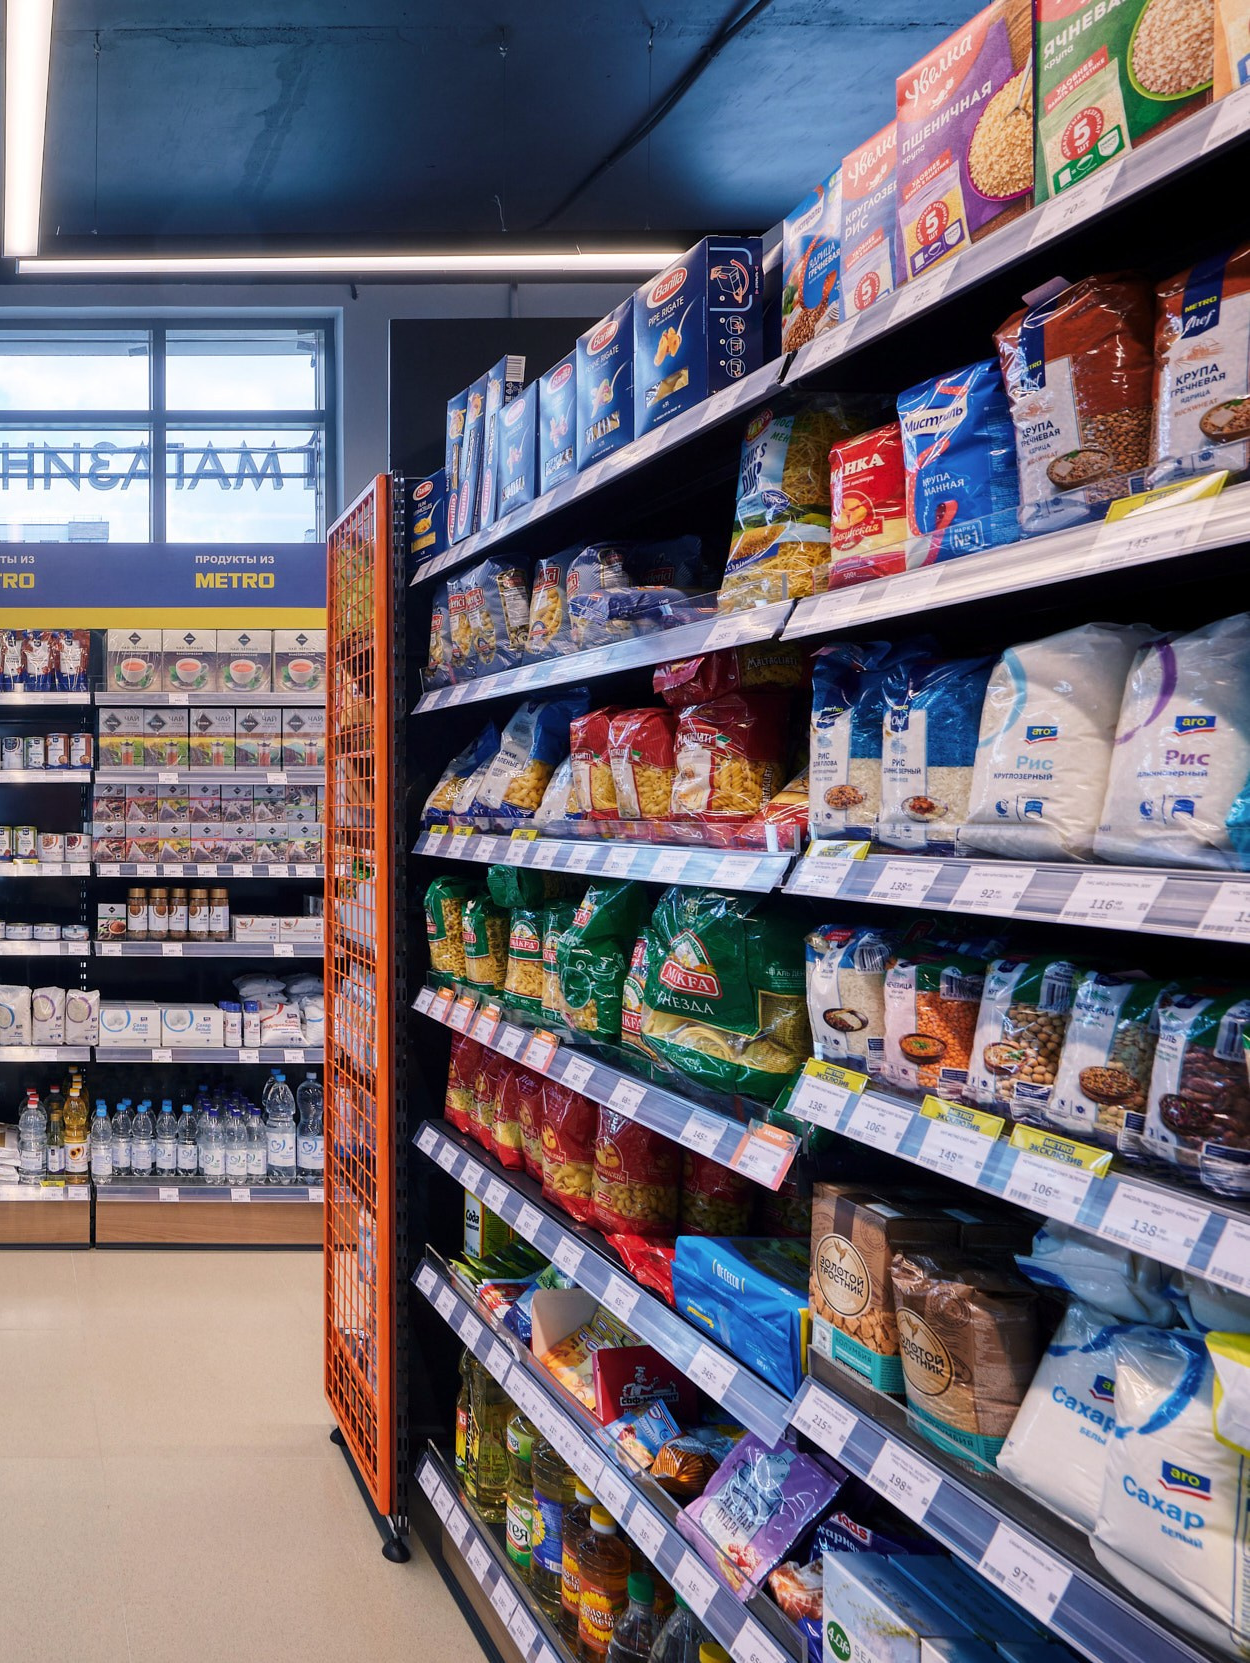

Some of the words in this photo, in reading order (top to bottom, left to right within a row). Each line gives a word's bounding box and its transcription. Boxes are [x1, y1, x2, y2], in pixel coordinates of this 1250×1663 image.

[1043, 0, 1128, 61] ЯЧНЕВА
[1044, 44, 1075, 71] крупа
[1055, 58, 1095, 96] УДОБНЕЕ
[902, 79, 992, 155] ПШЕНИЧНАЯ
[1074, 118, 1091, 147] 5
[901, 144, 926, 166] крупа
[1077, 141, 1090, 155] ШТ
[910, 158, 941, 189] УДОБНЕЕ
[845, 214, 869, 241] РИС
[925, 210, 939, 235] 5
[928, 230, 939, 241] ШТ
[654, 271, 684, 301] Barilla
[861, 280, 873, 301] 5
[648, 312, 660, 327] PIPE
[661, 295, 684, 318] RIGATE
[1184, 295, 1218, 313] METRO
[593, 323, 618, 348] Barilla
[1170, 371, 1226, 398] ГРЕЧНЕВАЯ
[1175, 363, 1220, 387] КРУПА
[1180, 388, 1211, 405] ЯДРИЦА
[904, 405, 963, 433] Мистраль
[924, 477, 965, 497] МАННАЯ
[954, 523, 976, 534] МАРКА
[20, 555, 35, 564] ИЗ
[195, 555, 257, 565] ПРОДУКТЫ
[260, 555, 275, 564] ИЗ
[195, 573, 275, 589] METRO
[1032, 727, 1051, 736] aro
[1182, 717, 1207, 727] aro
[817, 752, 830, 760] РИС
[891, 759, 906, 767] РИС
[1016, 755, 1054, 771] Рис
[1165, 749, 1211, 766] Рис
[993, 772, 1053, 781] КРУГЛОЗЕРНЫЙ
[815, 1071, 850, 1088] ЭКСКЛЮЗИВ
[935, 1112, 981, 1133] ЭКСКЛЮЗИВ
[1028, 1142, 1083, 1168] ЭКСКЛЮЗИВ
[1043, 1138, 1075, 1155] METRO
[465, 1209, 480, 1224] Сода
[819, 1264, 864, 1298] ТРОСТНИК
[820, 1255, 864, 1287] ЗОЛОТОЙ
[900, 1332, 944, 1369] ОЛОТОЙ
[1052, 1385, 1116, 1434] Сахар
[1079, 1426, 1107, 1446] БЕЛЫ
[1170, 1466, 1201, 1488] aro
[1123, 1474, 1205, 1530] Сахар
[715, 1507, 739, 1538] ПУДРА
[1161, 1524, 1203, 1550] БЕЛЫЙ
